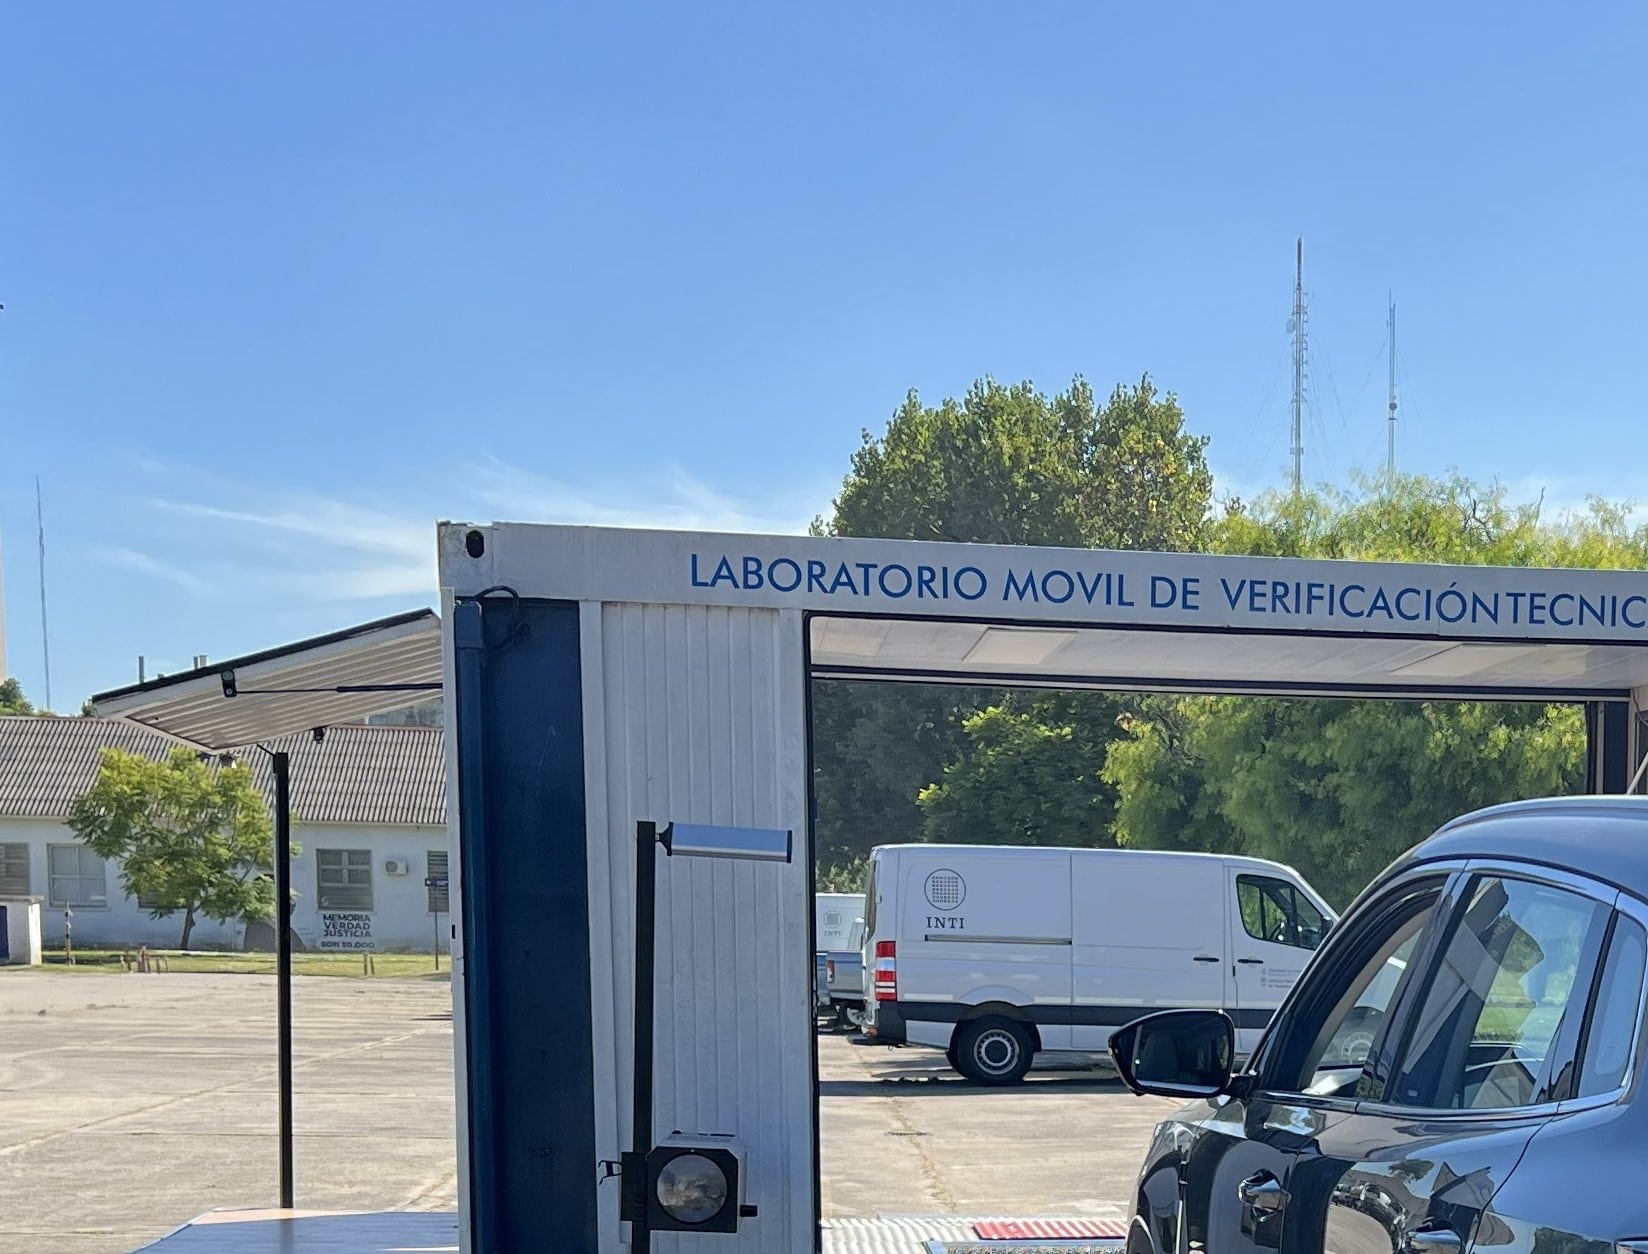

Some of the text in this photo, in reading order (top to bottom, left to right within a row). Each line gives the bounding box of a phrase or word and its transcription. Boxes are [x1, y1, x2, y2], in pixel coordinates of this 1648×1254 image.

[690, 553, 987, 601] LABORATORIO
[1002, 568, 1135, 608] MOVIL
[1150, 575, 1201, 611] DE
[1221, 577, 1499, 626] VERIFICACIÓN
[323, 914, 371, 922] MEMORIA
[926, 916, 965, 929] INTI
[324, 922, 370, 930] VERDAD
